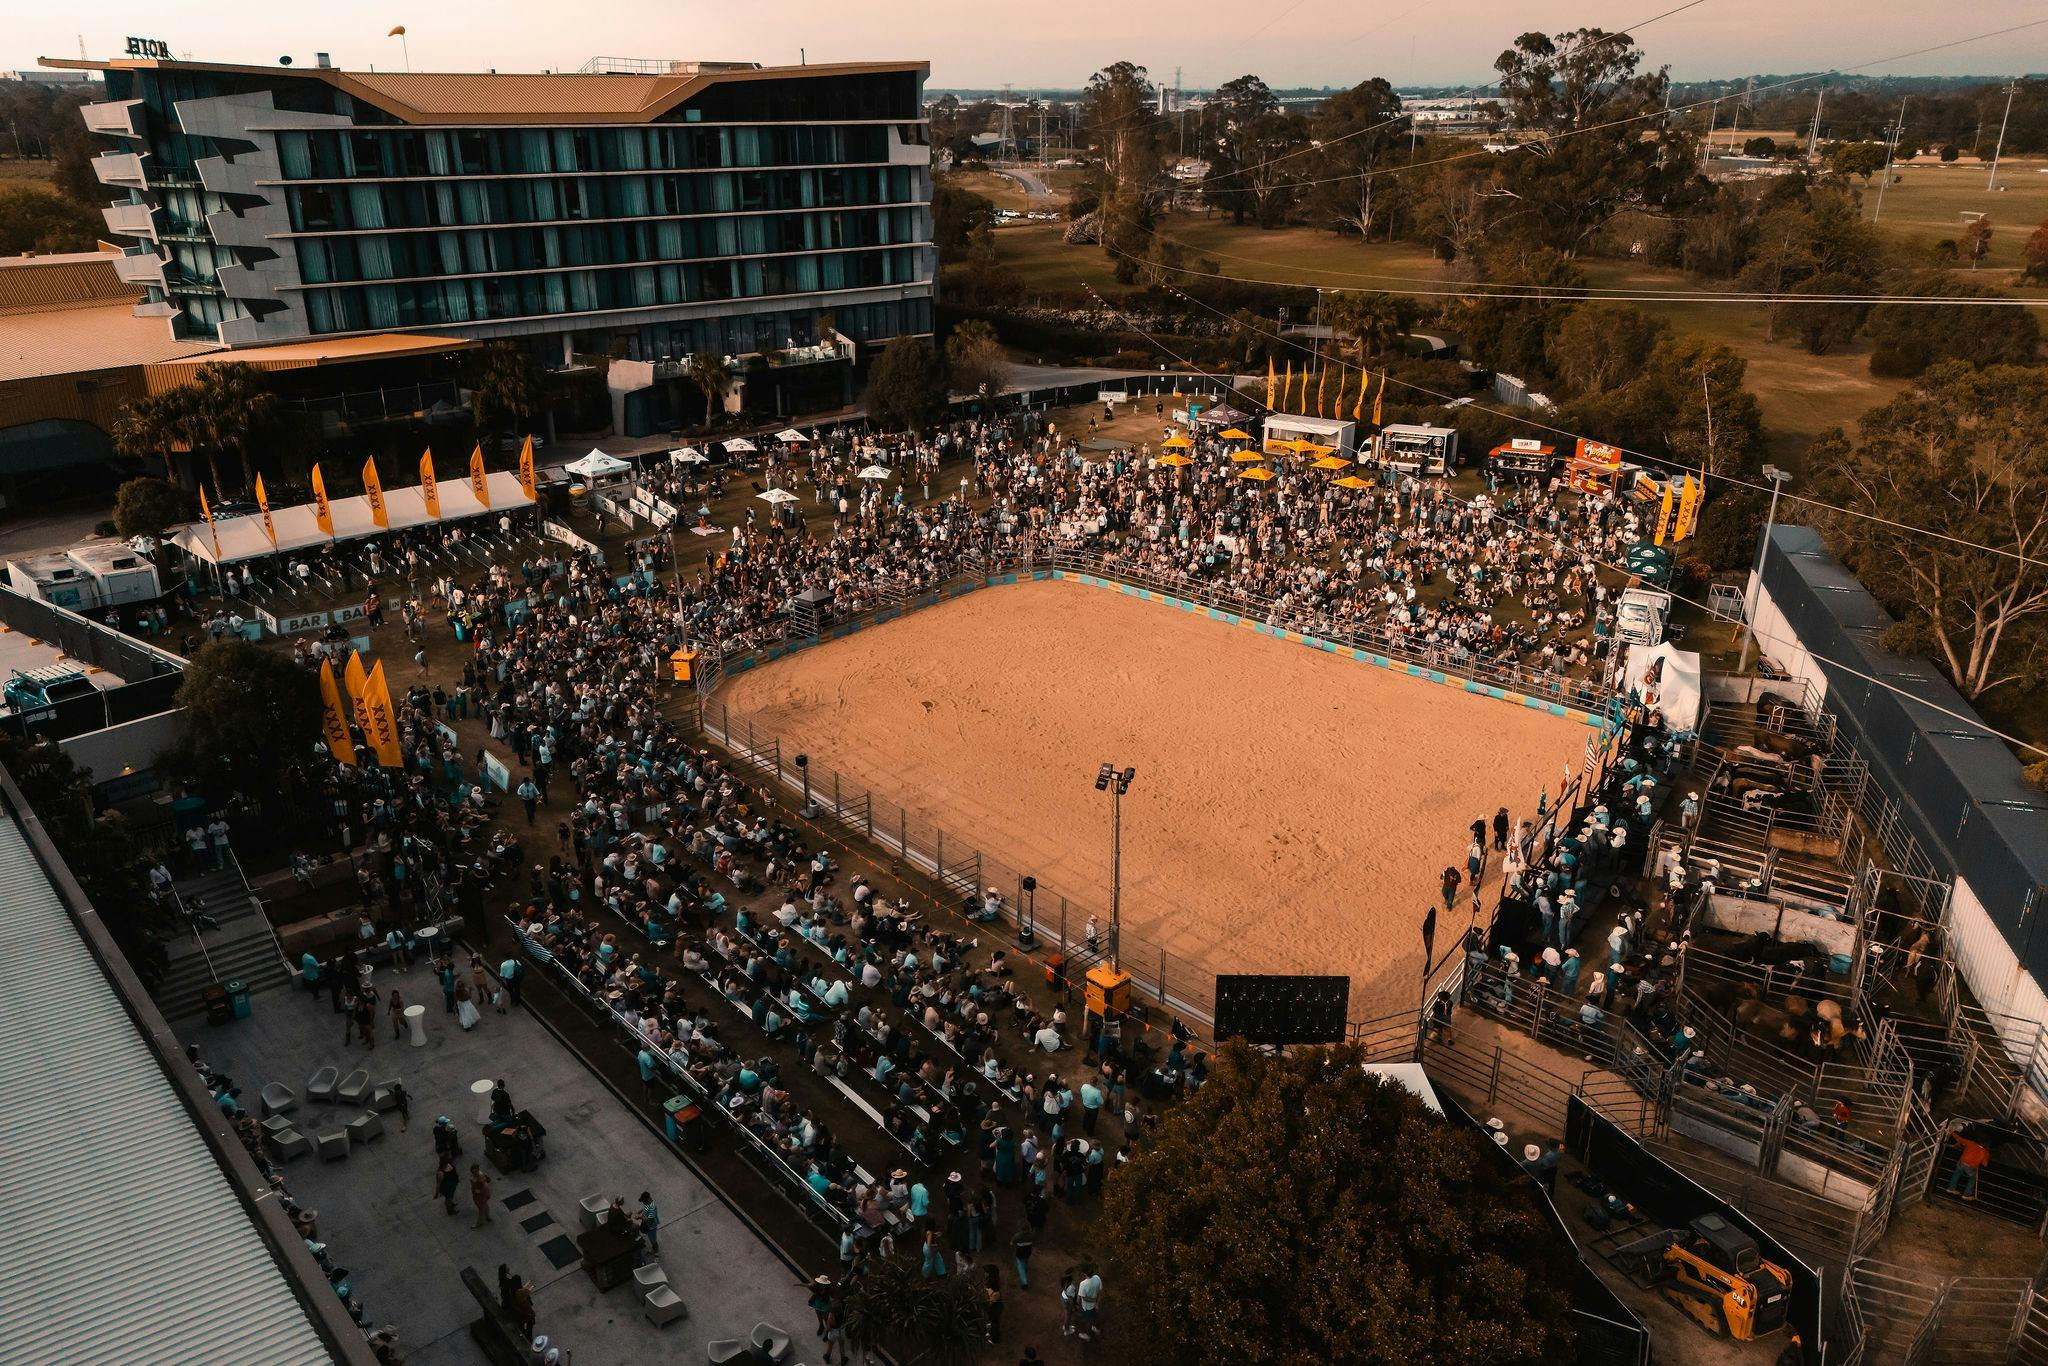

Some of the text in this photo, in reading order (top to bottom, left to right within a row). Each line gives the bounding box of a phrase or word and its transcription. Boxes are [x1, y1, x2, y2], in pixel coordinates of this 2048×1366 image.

[472, 466, 484, 492] XXXX
[523, 460, 533, 485] XXXX
[367, 484, 381, 510] XXXX
[424, 474, 436, 501] XXXX
[260, 501, 271, 529] XXXX
[315, 491, 327, 518] XXXX
[1680, 500, 1692, 527] XXXX
[1657, 509, 1668, 536] XXXX
[289, 615, 321, 631] BAR
[342, 607, 364, 621] BA
[324, 703, 347, 742] XXXX
[371, 703, 391, 746] XXXX
[1732, 1291, 1745, 1306] CAT
